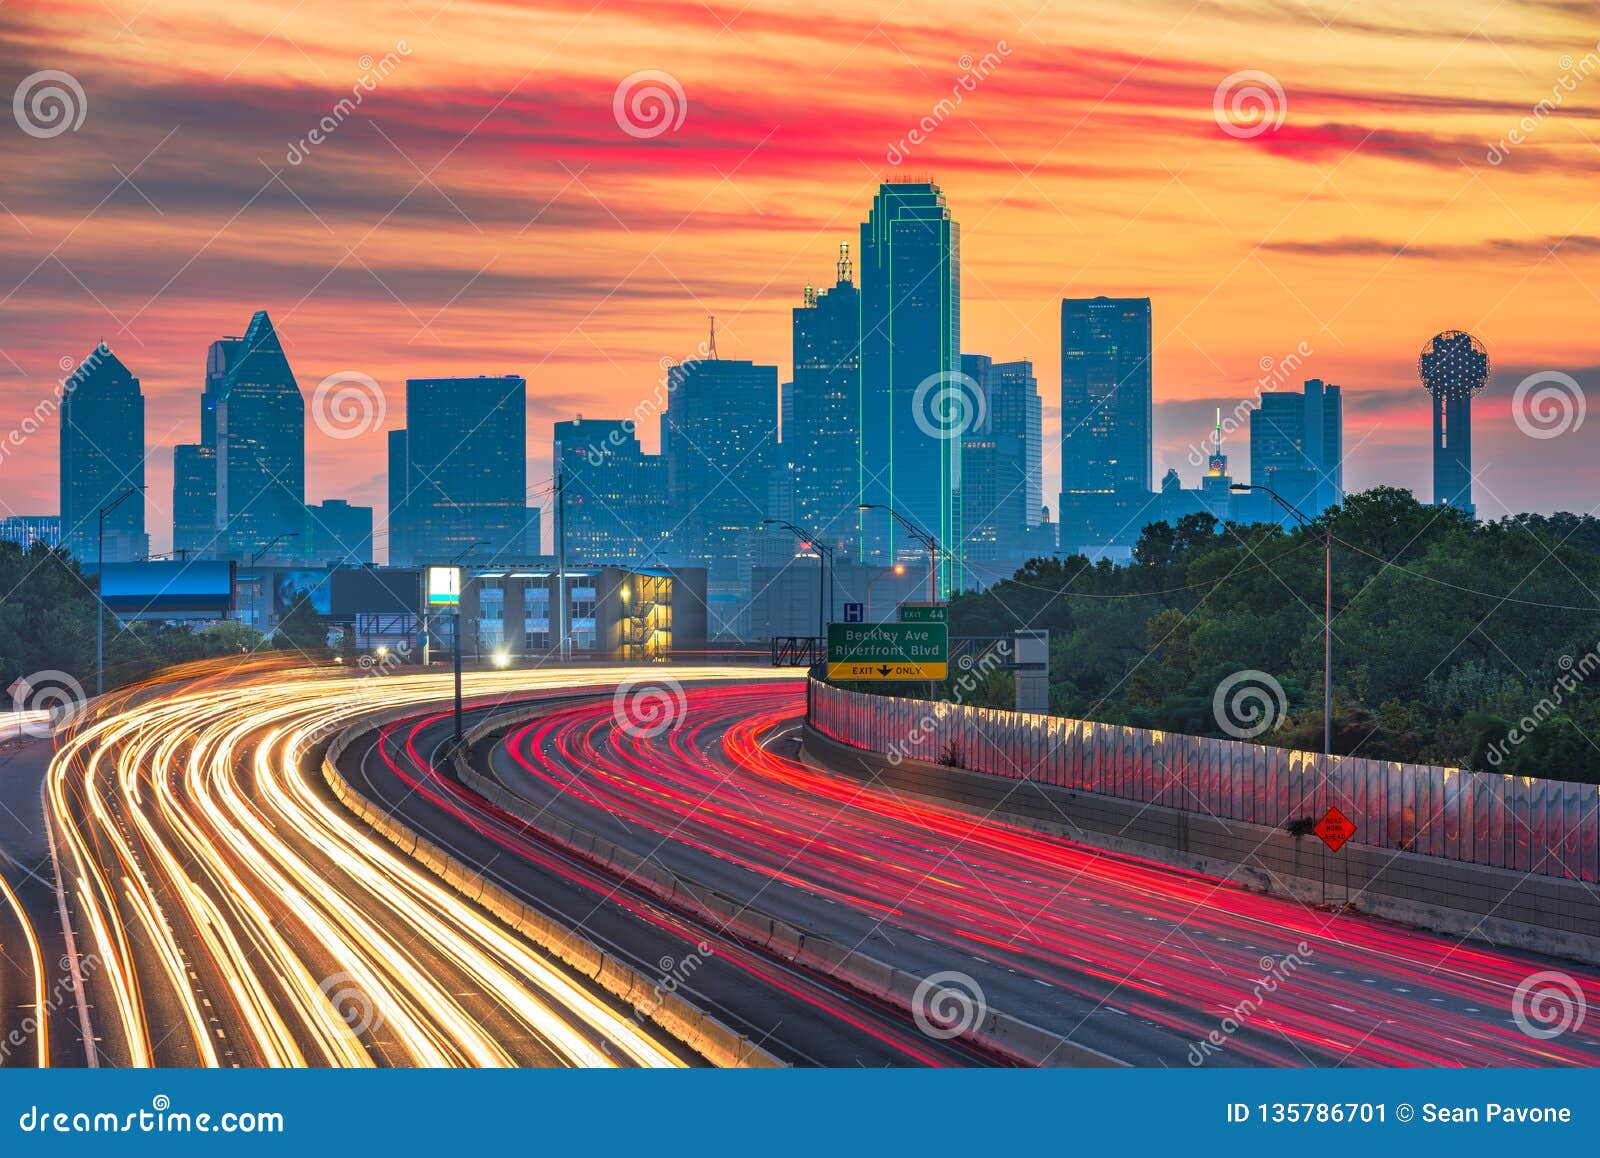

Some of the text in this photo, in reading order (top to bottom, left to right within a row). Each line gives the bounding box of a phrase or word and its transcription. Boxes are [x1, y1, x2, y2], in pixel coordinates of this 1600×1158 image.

[846, 604, 861, 621] H
[929, 609, 944, 618] 44
[846, 630, 929, 643] Beckley Ave
[836, 645, 939, 656] Riverfront Blvd
[852, 667, 922, 675] EXIT ONLY
